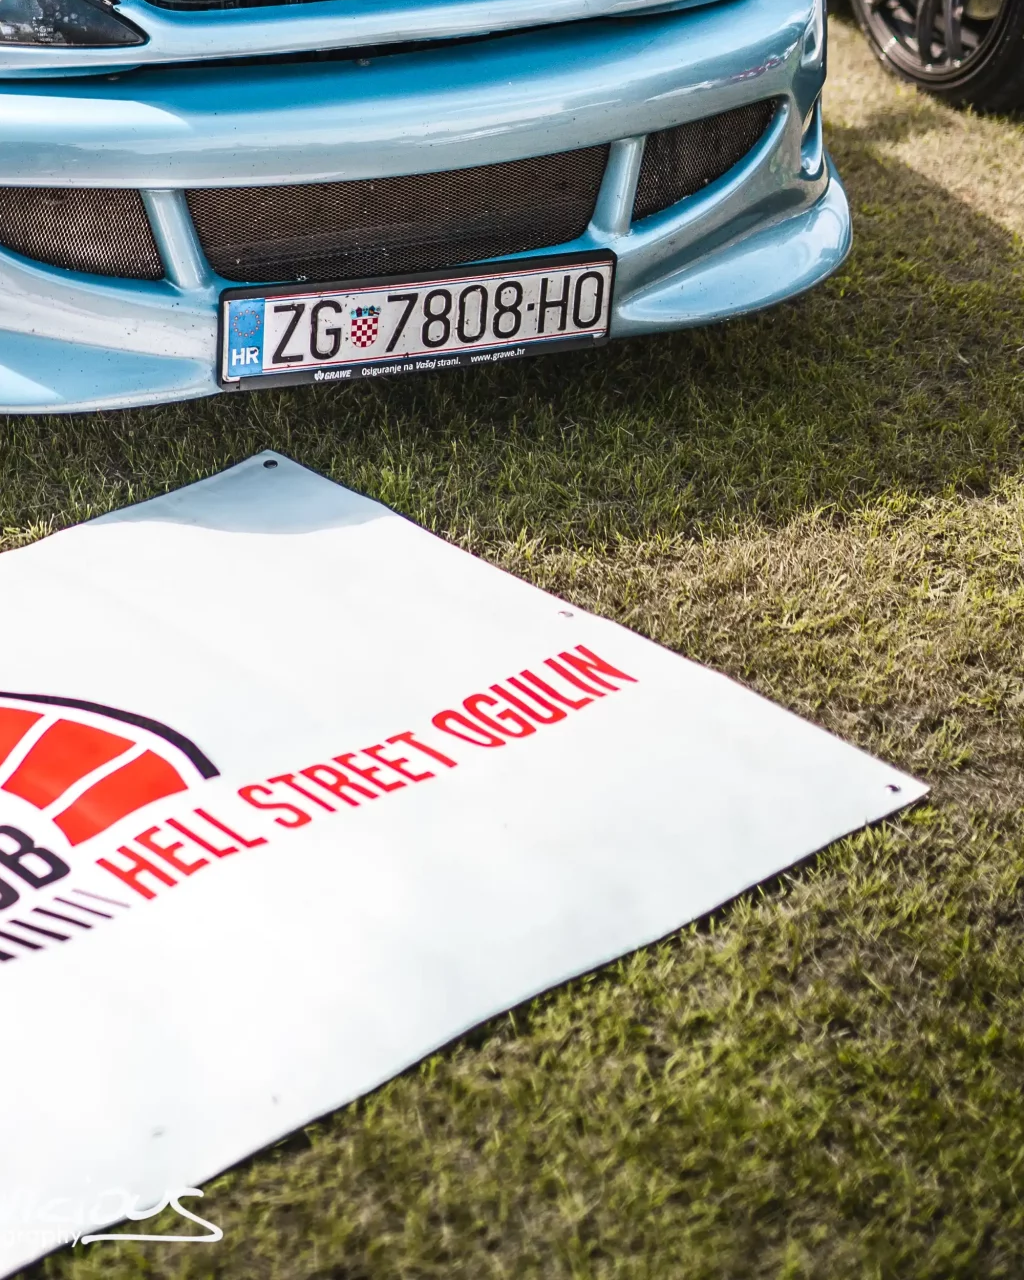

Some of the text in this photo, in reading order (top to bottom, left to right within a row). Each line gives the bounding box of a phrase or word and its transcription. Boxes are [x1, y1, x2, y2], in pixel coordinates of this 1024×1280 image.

[231, 346, 260, 367] HR
[271, 299, 343, 365] ZG
[324, 369, 353, 381] GRAWE
[361, 364, 403, 377] Osiguranje
[403, 363, 415, 373] na
[415, 358, 437, 371] Vašoj
[470, 347, 527, 364] www.grawe.hr
[95, 644, 639, 901] HELL STREET OGULIN
